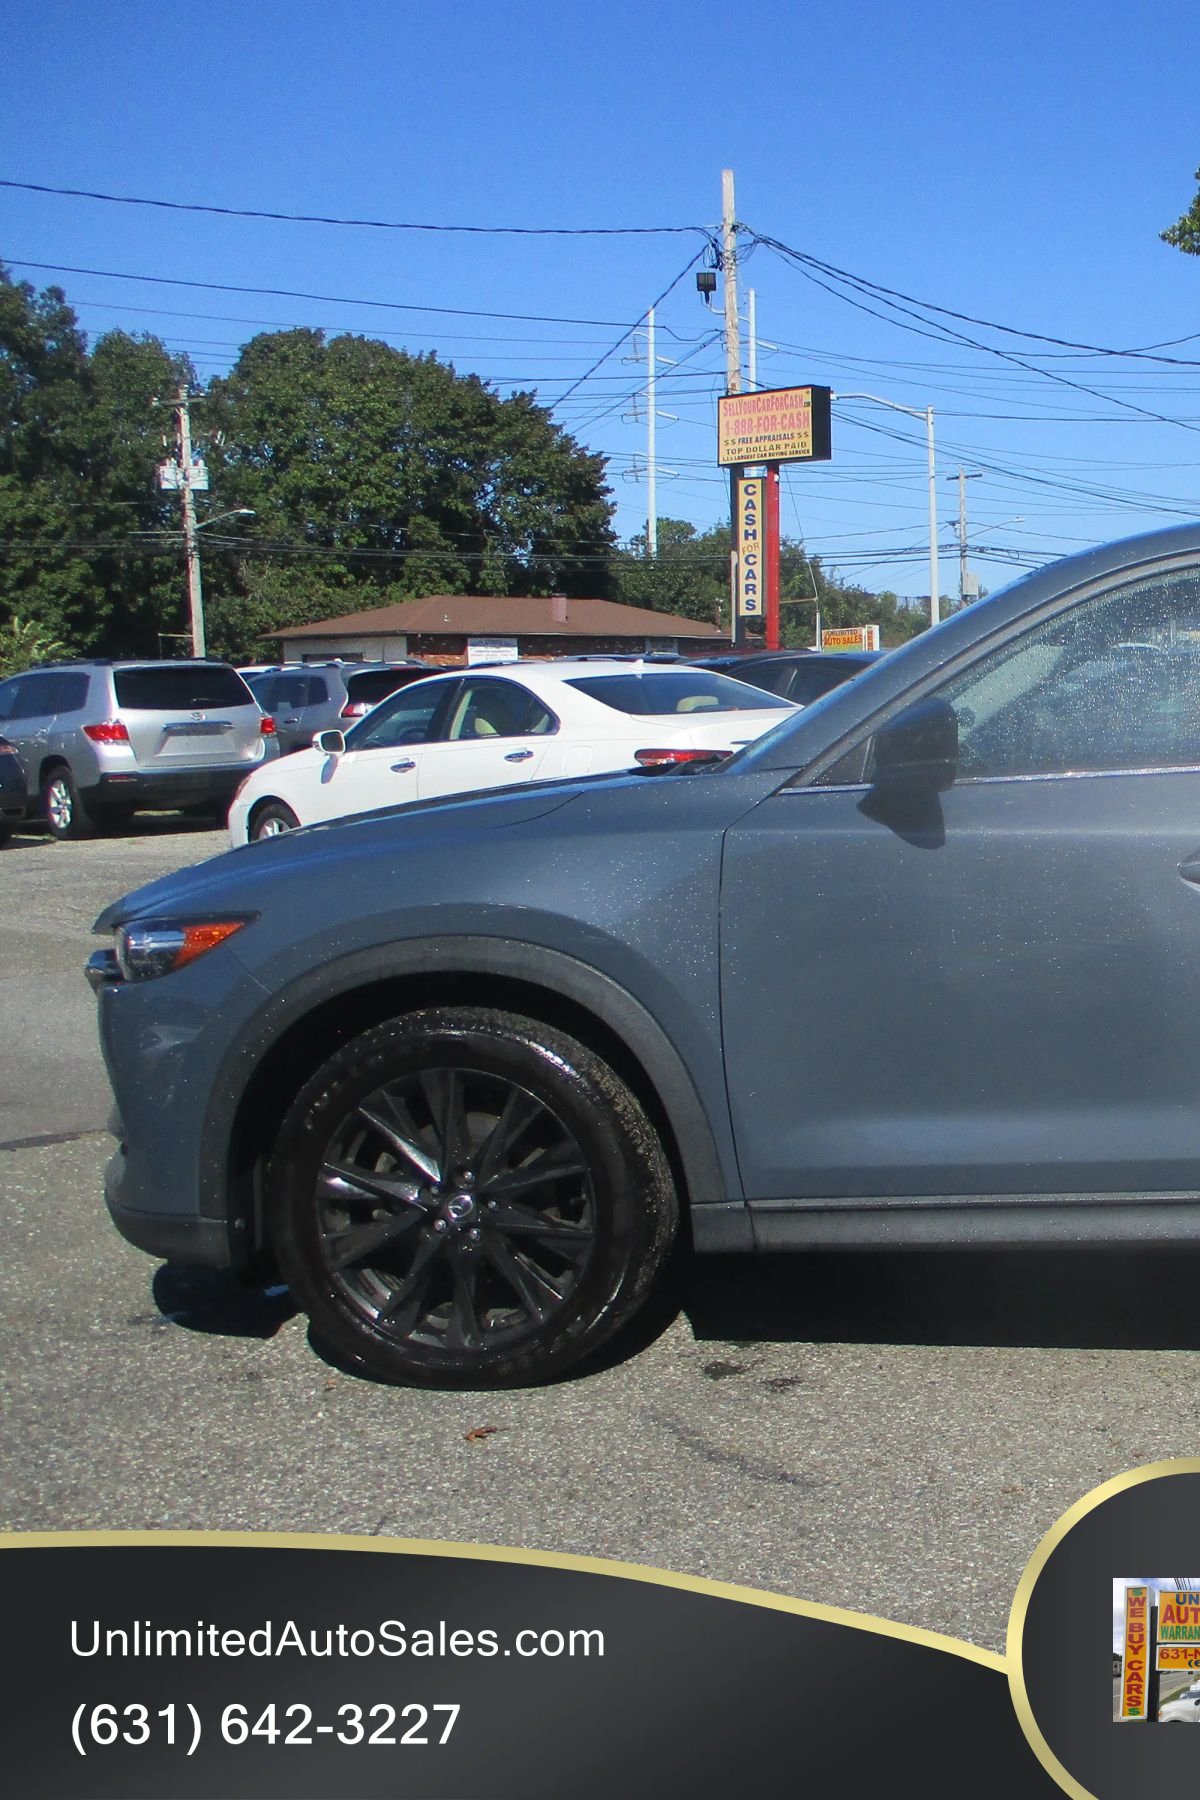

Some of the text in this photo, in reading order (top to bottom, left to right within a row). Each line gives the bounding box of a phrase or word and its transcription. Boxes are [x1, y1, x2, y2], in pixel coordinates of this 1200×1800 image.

[725, 411, 810, 436] 1-888-FOR-CASH
[738, 436, 753, 445] FREE
[754, 432, 795, 443] APPRAISALS
[726, 441, 807, 455] TOP DOLLAR PAID
[768, 450, 788, 458] BUYING
[788, 448, 810, 456] SERVICE
[741, 483, 760, 611] CASH FOR CARS
[824, 634, 842, 646] AUTO
[842, 634, 863, 645] SALES
